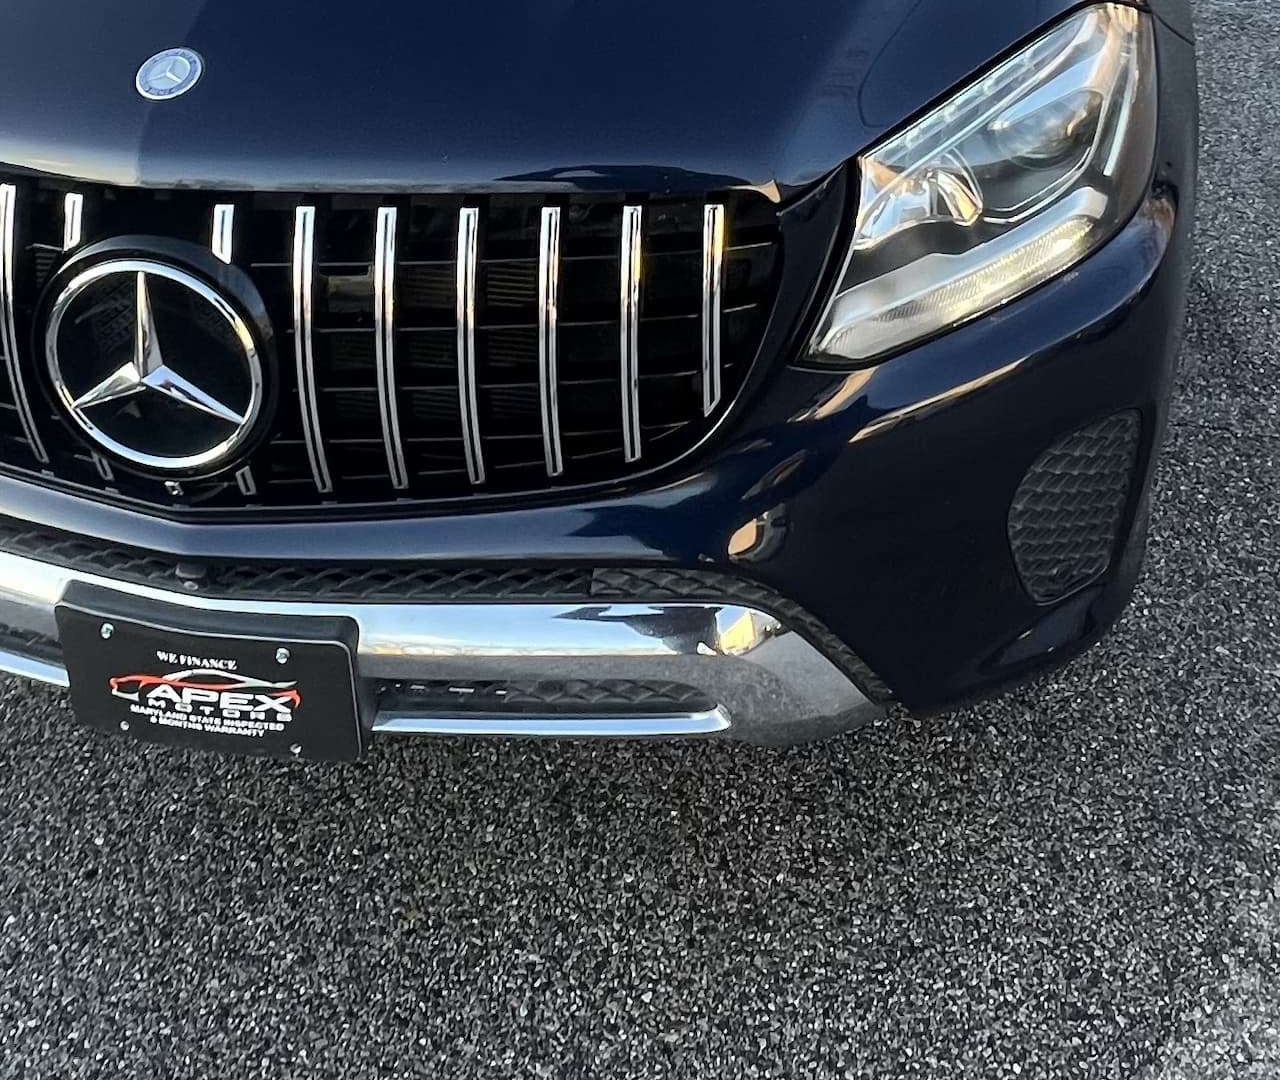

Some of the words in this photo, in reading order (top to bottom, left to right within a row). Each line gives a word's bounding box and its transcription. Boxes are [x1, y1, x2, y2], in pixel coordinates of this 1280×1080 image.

[156, 650, 178, 664] WE
[180, 654, 238, 670] FINANCE
[146, 684, 292, 714] APEX
[148, 698, 293, 722] MOTORS
[130, 704, 188, 721] MARYLAND
[189, 714, 221, 726] STATE
[223, 718, 285, 731] INSPECTED
[159, 716, 203, 731] MONTHS
[204, 723, 265, 737] WARRANTY
